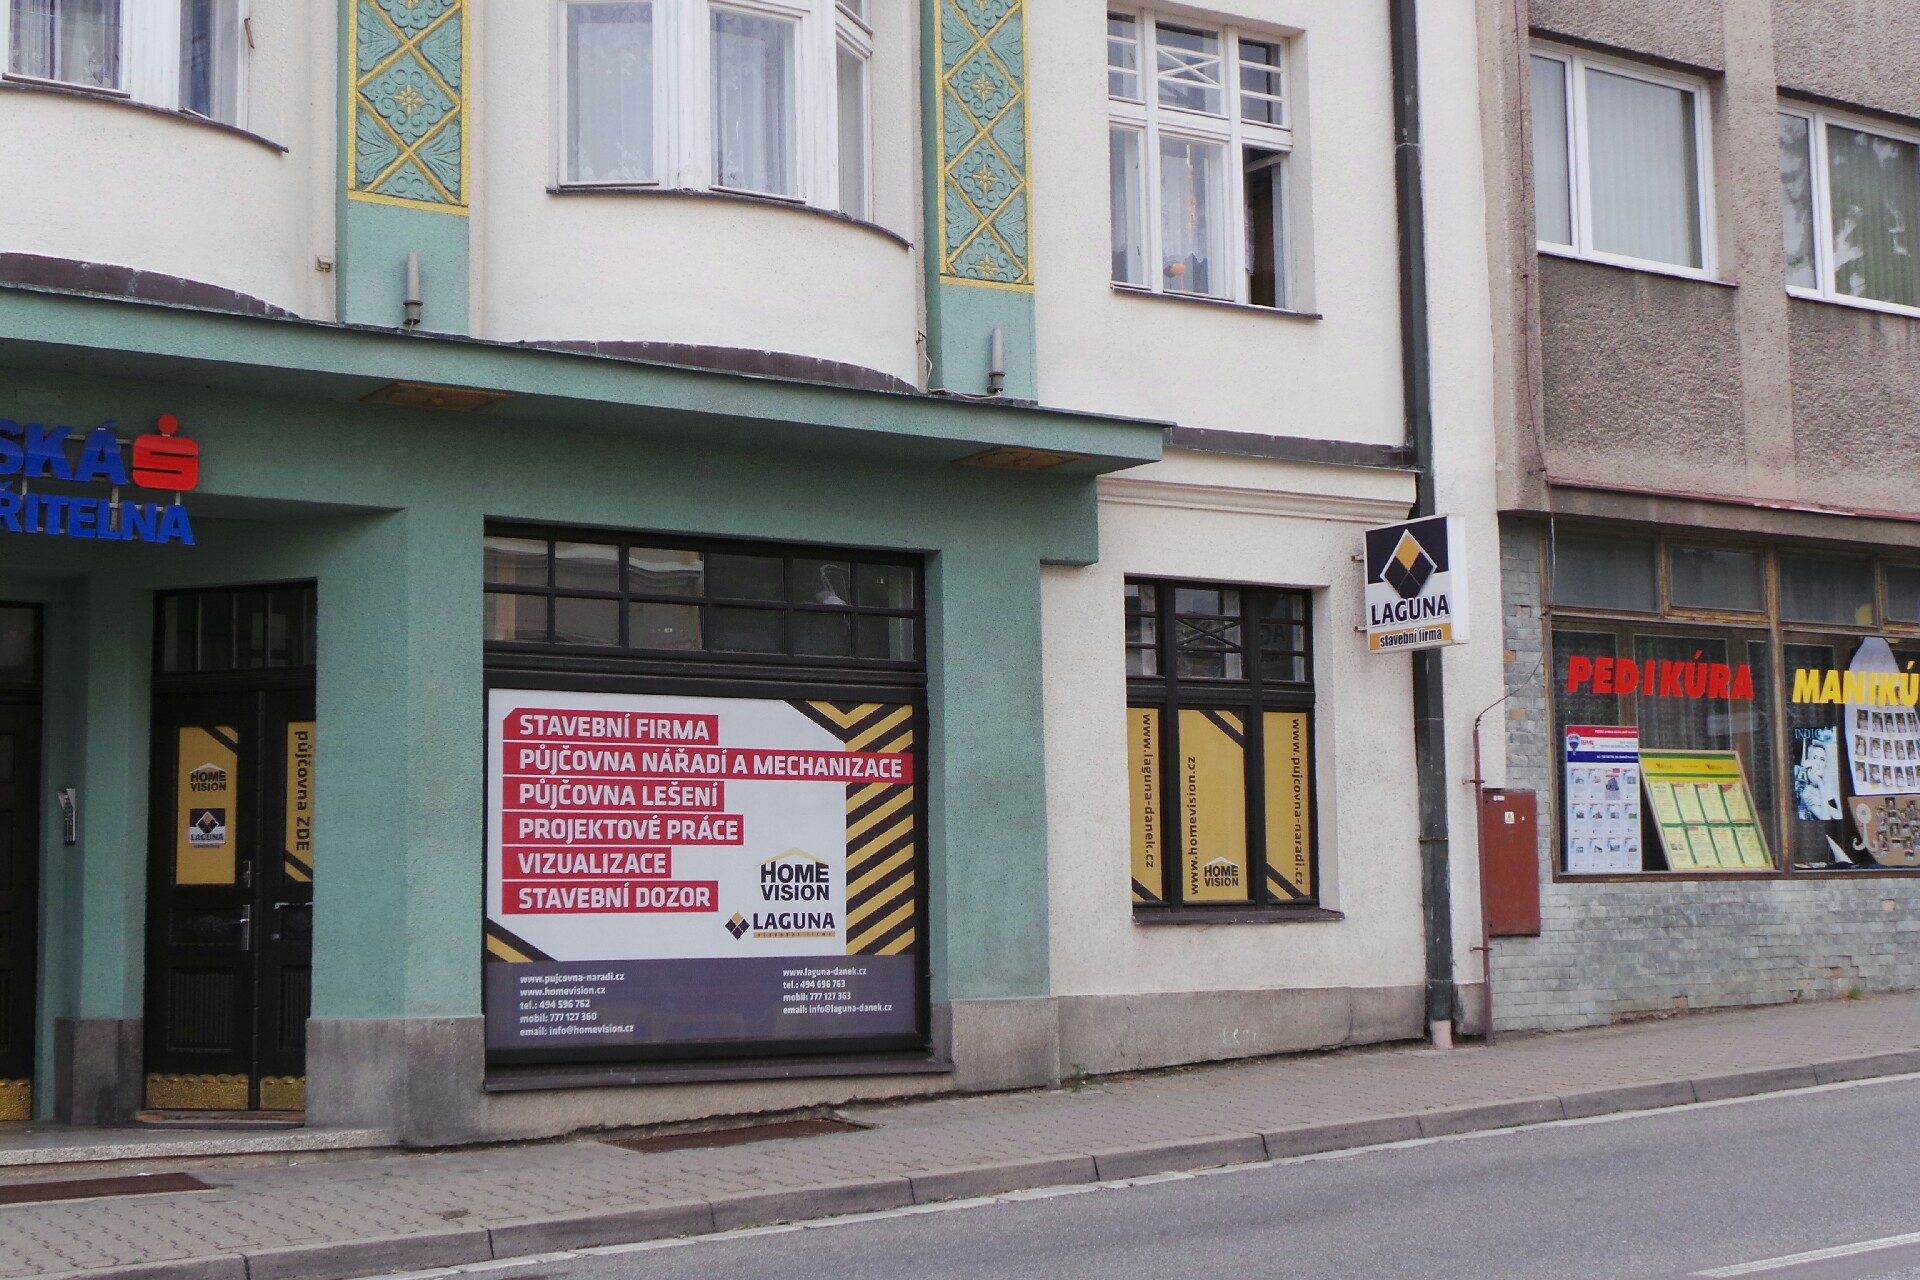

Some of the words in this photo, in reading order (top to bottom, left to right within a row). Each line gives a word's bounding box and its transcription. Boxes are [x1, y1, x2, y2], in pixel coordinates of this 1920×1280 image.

[1370, 594, 1450, 626] LAGUNA
[1418, 629, 1442, 643] firma
[1567, 650, 1755, 700] PEDIKÚRA
[519, 713, 631, 738] STAVEBNÍ
[636, 718, 710, 740] FIRMA
[519, 744, 636, 775] PŮJČOVNA
[642, 747, 728, 774] NÁŘADÍ
[732, 754, 748, 774] A
[753, 755, 902, 778] MECHANIZACE
[190, 769, 227, 783] HOME
[294, 731, 312, 811] půjčovna
[190, 782, 227, 792] VISION
[519, 778, 636, 809] PŮJČOVNA
[642, 781, 719, 807] LEŠENÍ
[1141, 714, 1156, 868] www.laguna-danek.cz
[1290, 719, 1305, 885] www.pujcovna-naradi.cz
[296, 816, 310, 851] ZDE
[518, 814, 661, 844] PROJEKTOVÉ
[667, 814, 738, 840] PRÁCE
[1186, 756, 1199, 895] www.homevision.cz
[518, 853, 666, 874] VIZUALIZACE
[760, 860, 830, 884] HOME
[1204, 864, 1239, 877] HOME
[1204, 877, 1239, 887] VISION
[518, 882, 630, 909] STAVEBNÍ
[635, 887, 711, 907] DOZOR
[760, 884, 830, 901] VISION
[752, 912, 836, 930] LAGUNA
[520, 972, 625, 985] www.pujcovna-naradi.cz
[783, 966, 867, 978] www.laguna-danek.cz
[520, 985, 606, 997] www.homevision.cz
[800, 980, 815, 989] 494
[539, 1000, 556, 1009] 494
[575, 999, 591, 1008] 762
[783, 992, 808, 1002] mobil:
[809, 992, 822, 1001] 777
[824, 992, 836, 1000] 127
[783, 1004, 807, 1014] email:
[809, 1003, 893, 1015] info@laguna-danek.cz
[520, 1013, 548, 1024] mobil:
[550, 1013, 564, 1022] 777
[565, 1012, 579, 1021] 127
[581, 1012, 598, 1021] 360
[520, 1026, 547, 1037] email:
[549, 1024, 635, 1036] info@homevision.cz
